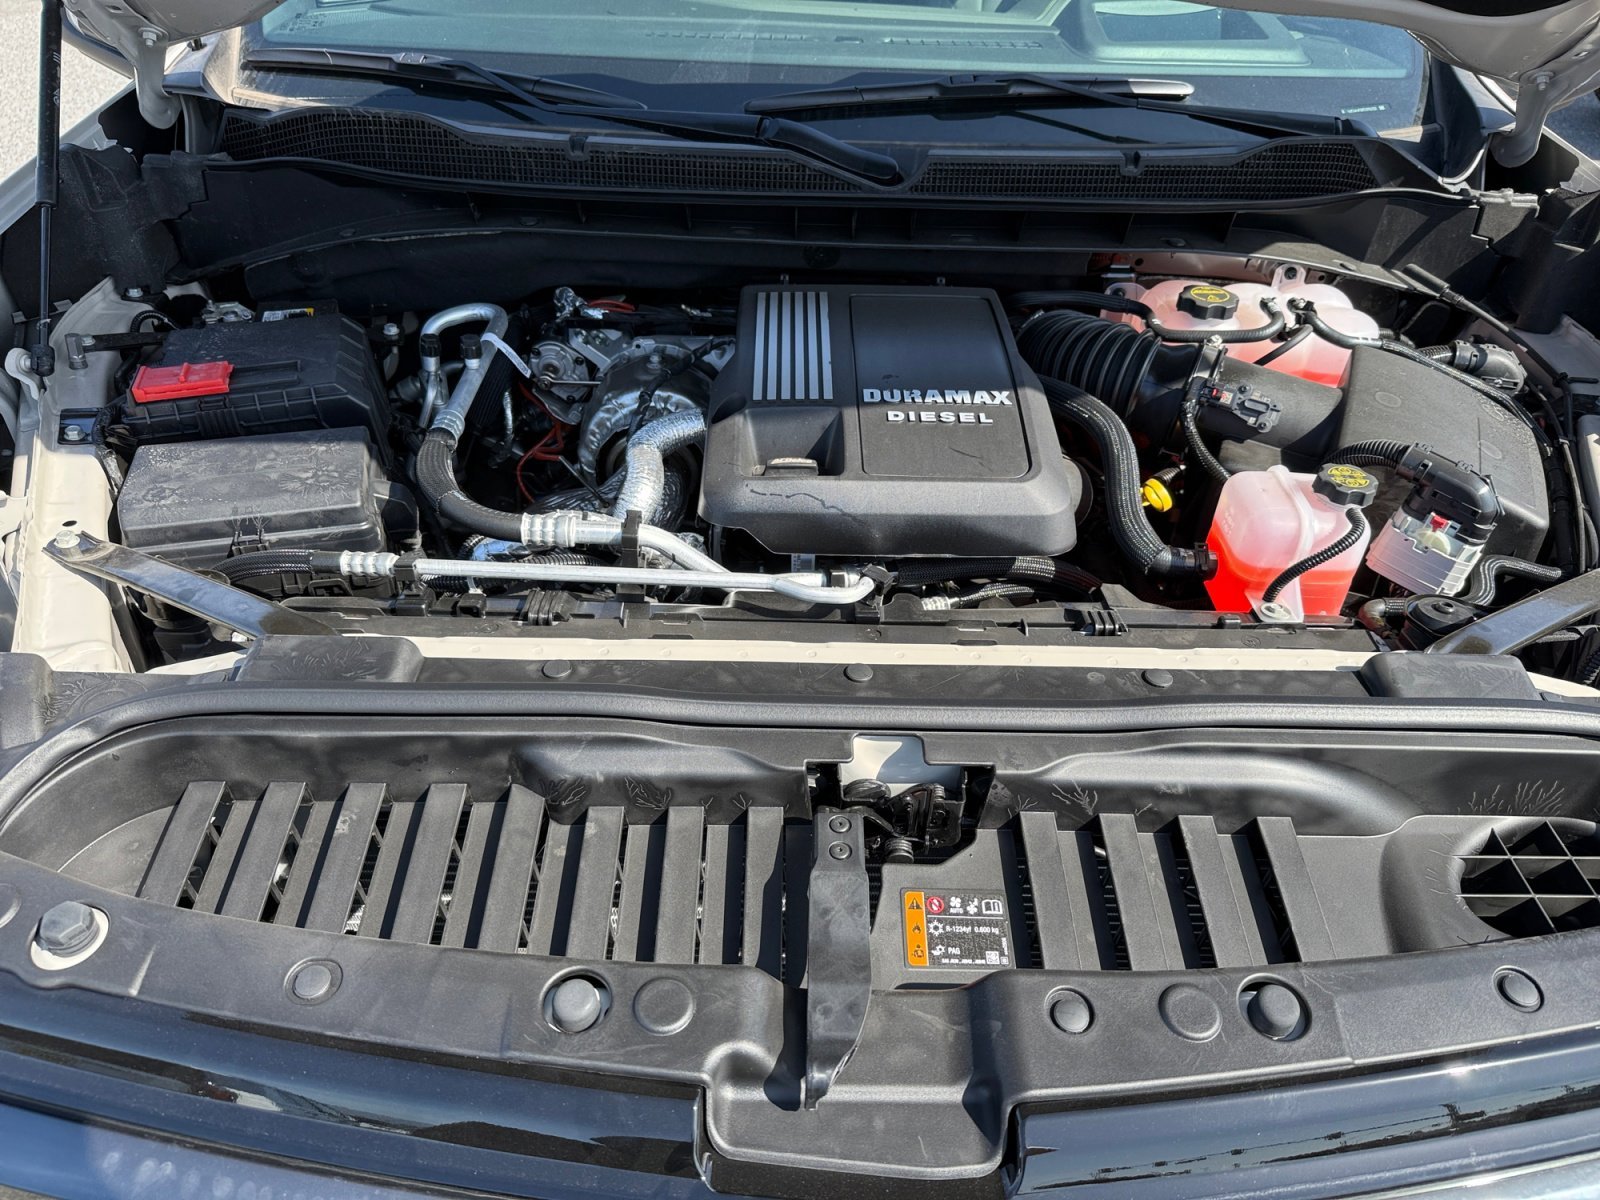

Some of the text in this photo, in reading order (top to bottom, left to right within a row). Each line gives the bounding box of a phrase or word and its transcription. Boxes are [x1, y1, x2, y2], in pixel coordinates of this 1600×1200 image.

[862, 388, 1013, 405] DURAMAX
[886, 410, 994, 423] DIESEL
[991, 926, 999, 935] kg
[947, 947, 960, 955] PAG
